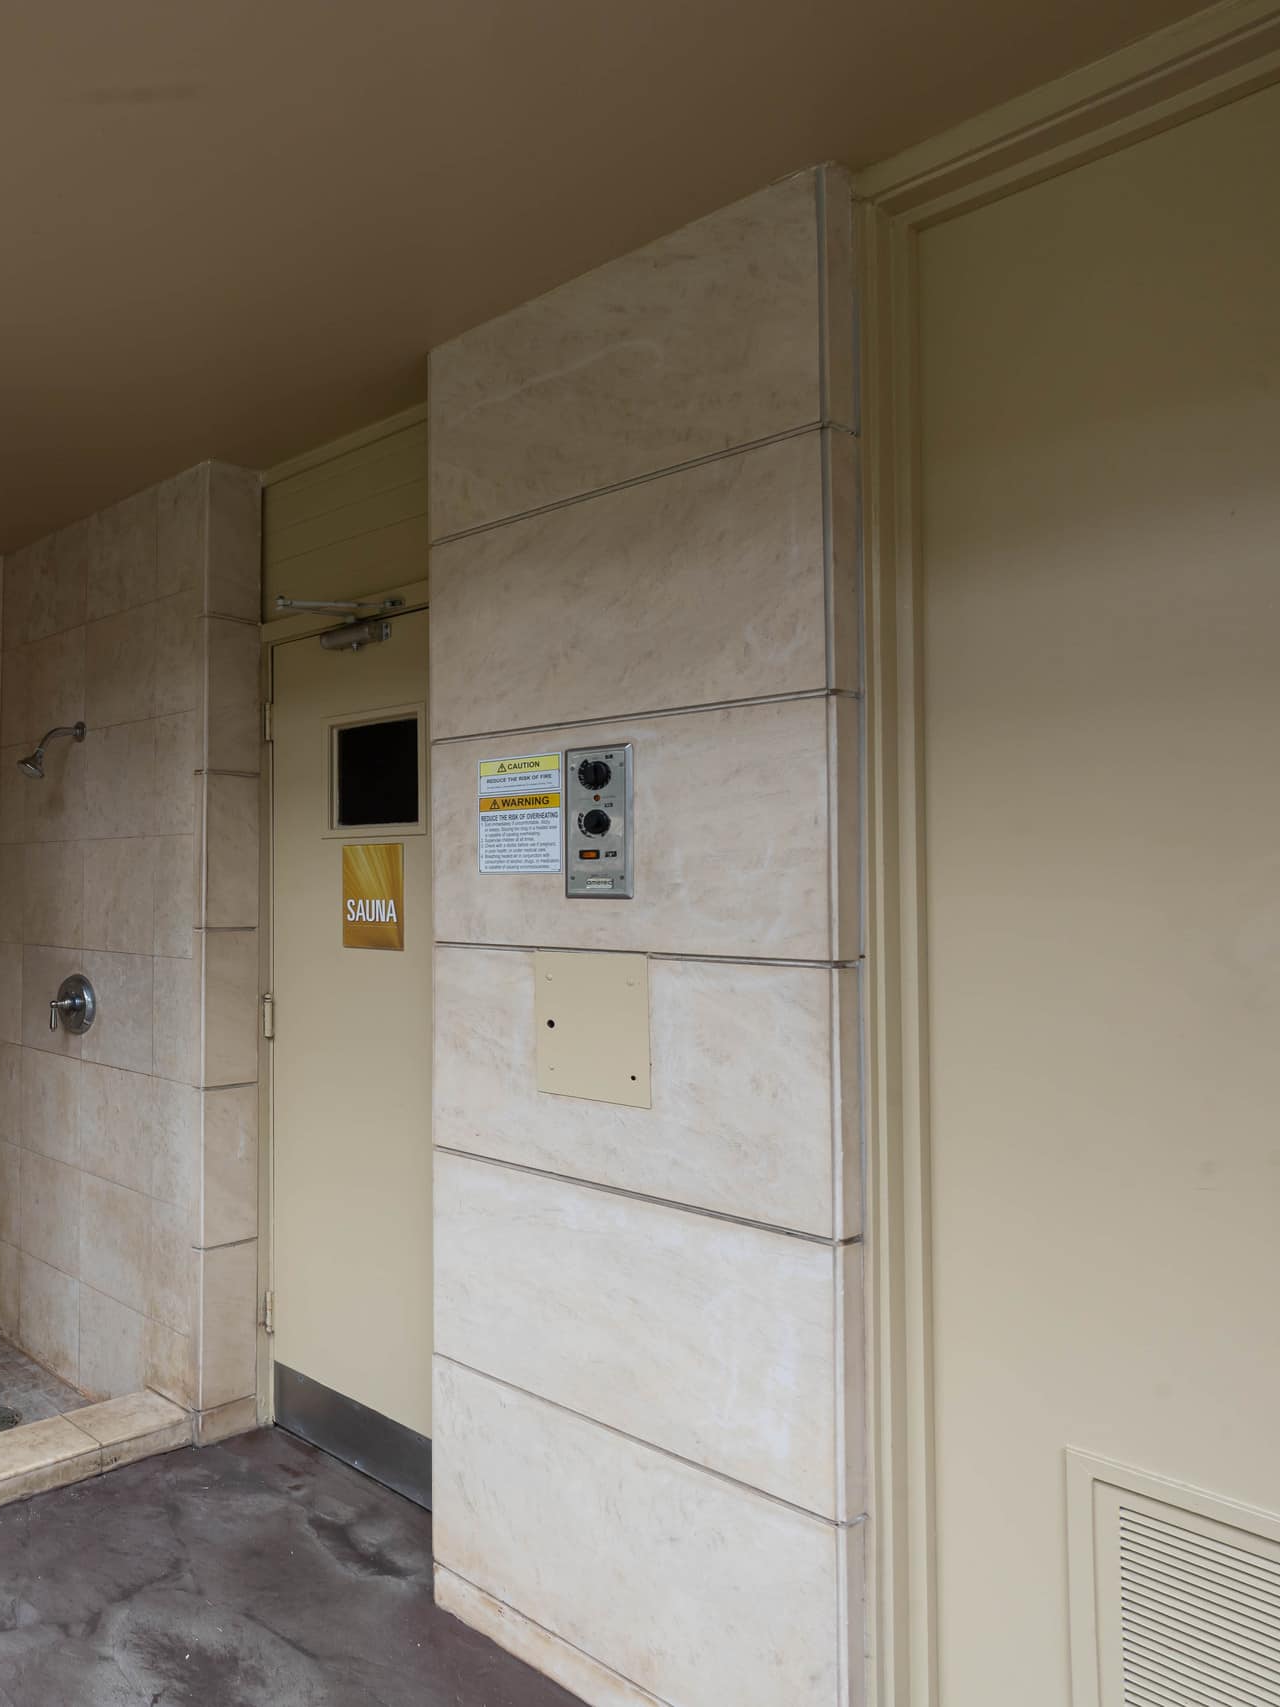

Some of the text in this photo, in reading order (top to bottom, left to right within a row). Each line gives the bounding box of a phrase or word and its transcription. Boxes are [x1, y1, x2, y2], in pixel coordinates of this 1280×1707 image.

[507, 760, 540, 770] CAUTION
[501, 796, 550, 808] WARNING
[346, 898, 398, 923] SAUNA
